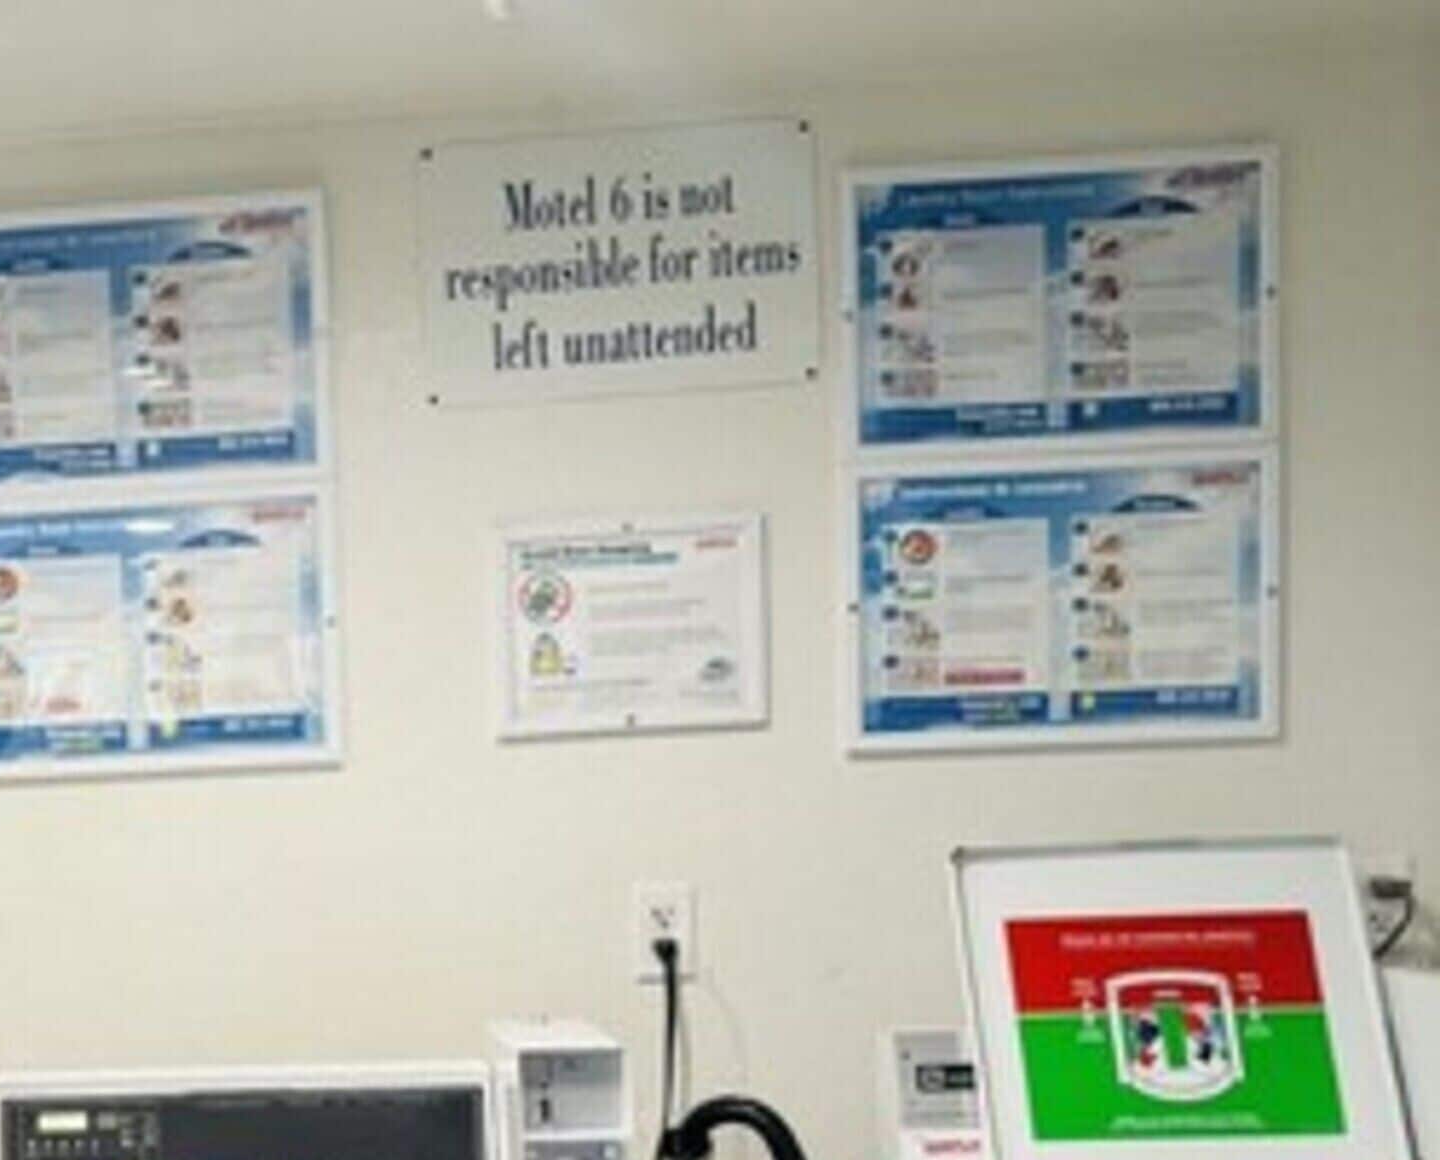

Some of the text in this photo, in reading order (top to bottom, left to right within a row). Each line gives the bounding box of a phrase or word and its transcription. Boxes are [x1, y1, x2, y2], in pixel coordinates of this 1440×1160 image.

[503, 172, 734, 231] Motel 6 is not
[446, 229, 802, 311] responsible for items
[492, 300, 757, 371] left unattended
